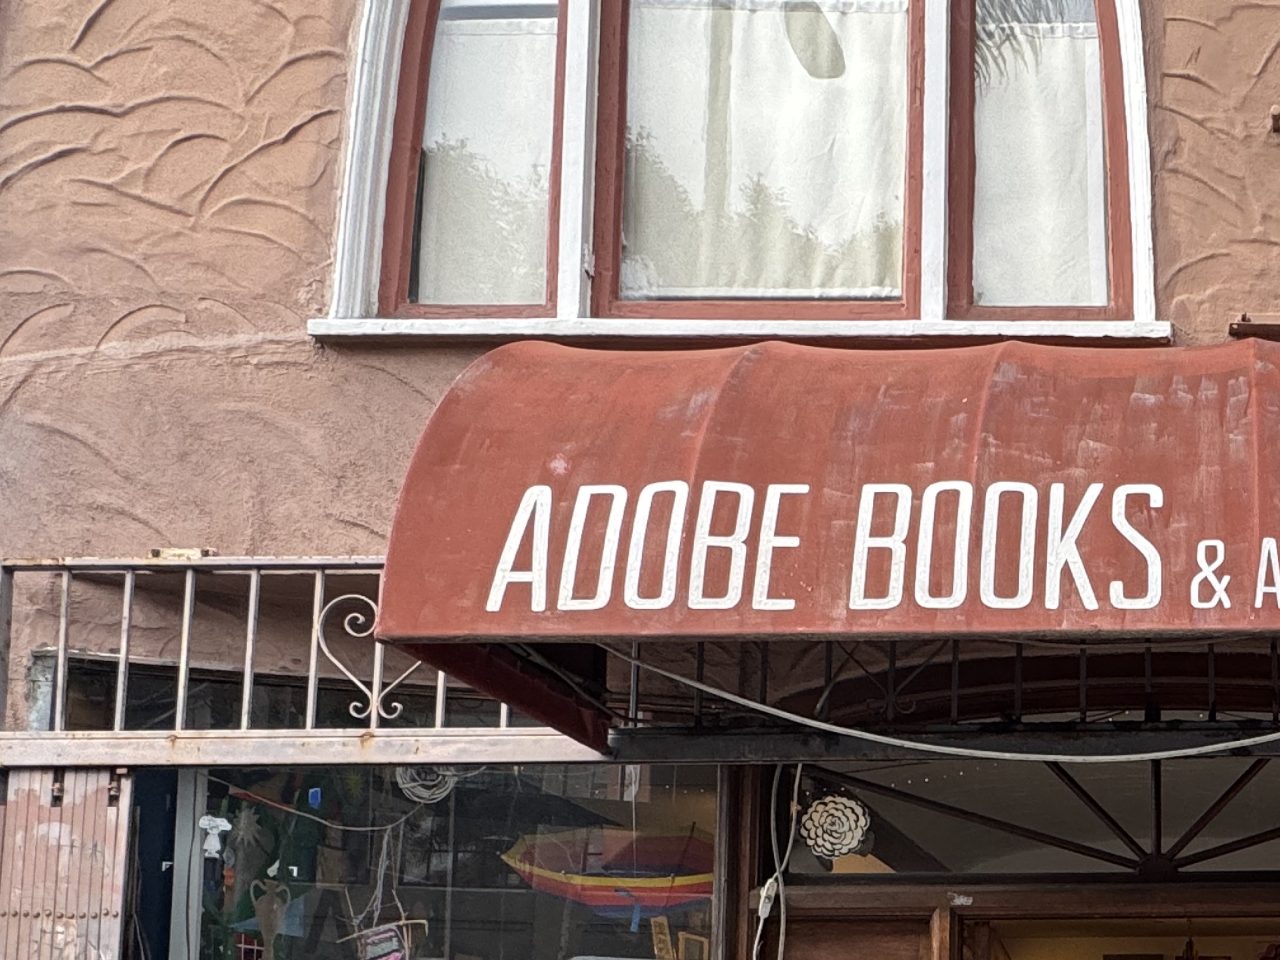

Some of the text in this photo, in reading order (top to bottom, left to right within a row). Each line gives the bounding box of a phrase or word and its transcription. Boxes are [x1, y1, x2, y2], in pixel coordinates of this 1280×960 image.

[486, 480, 810, 612] ADOBE
[849, 480, 1164, 611] BOOKS
[1190, 539, 1232, 609] &
